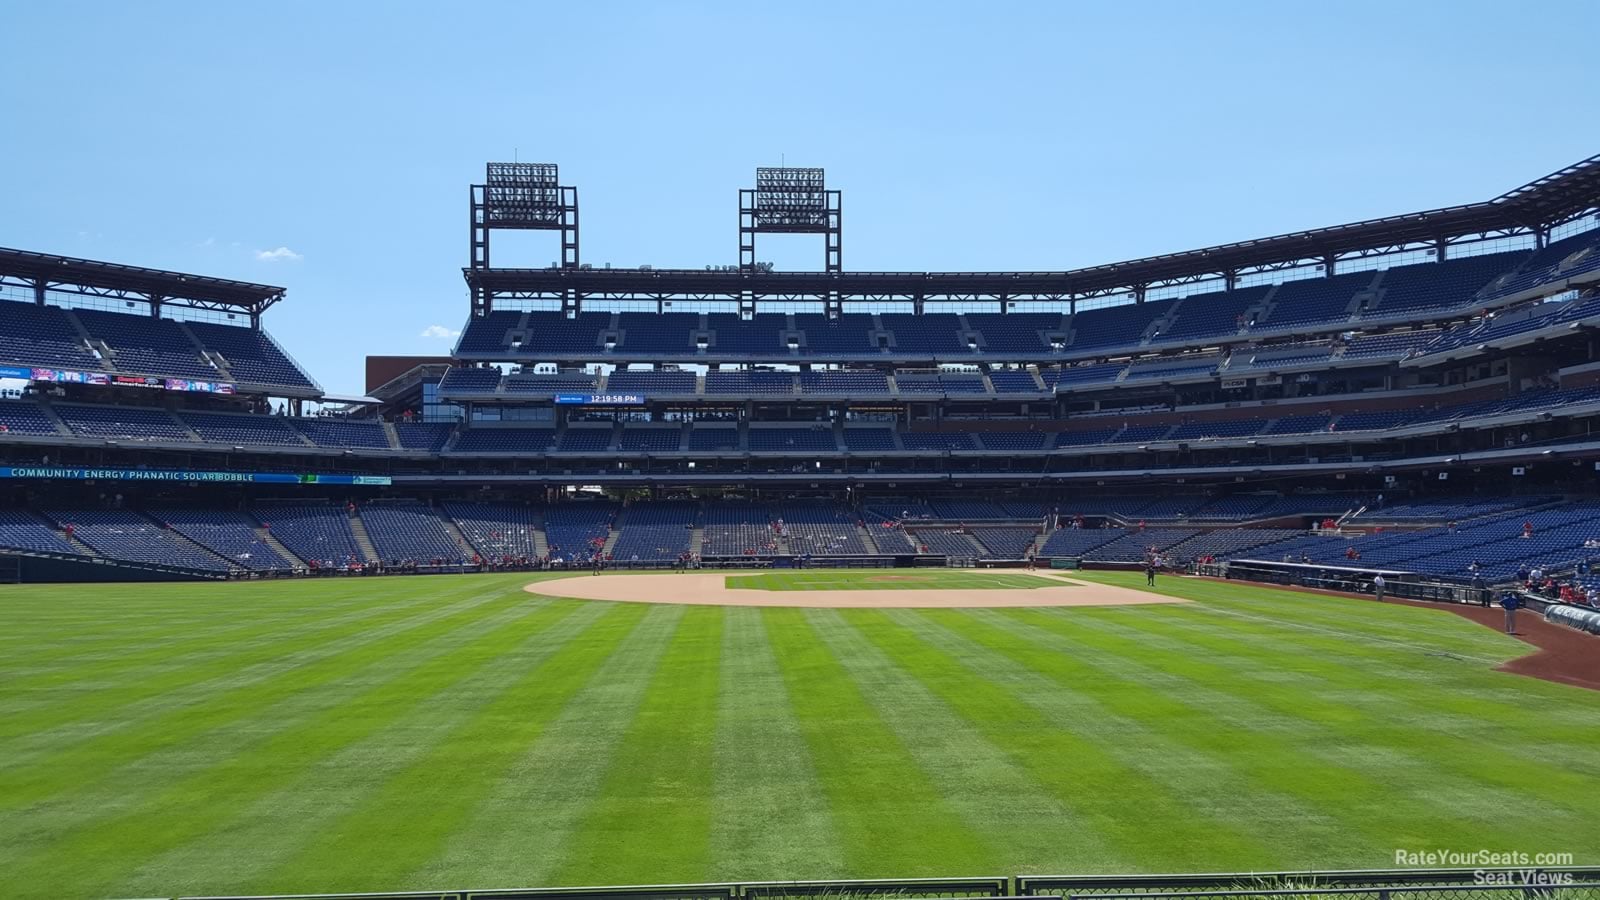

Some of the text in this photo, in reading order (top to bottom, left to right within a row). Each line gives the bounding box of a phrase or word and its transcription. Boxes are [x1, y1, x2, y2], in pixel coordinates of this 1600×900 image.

[11, 468, 253, 481] COMMUNITY ENERGY PHANATIC SOLAR BOBBLE
